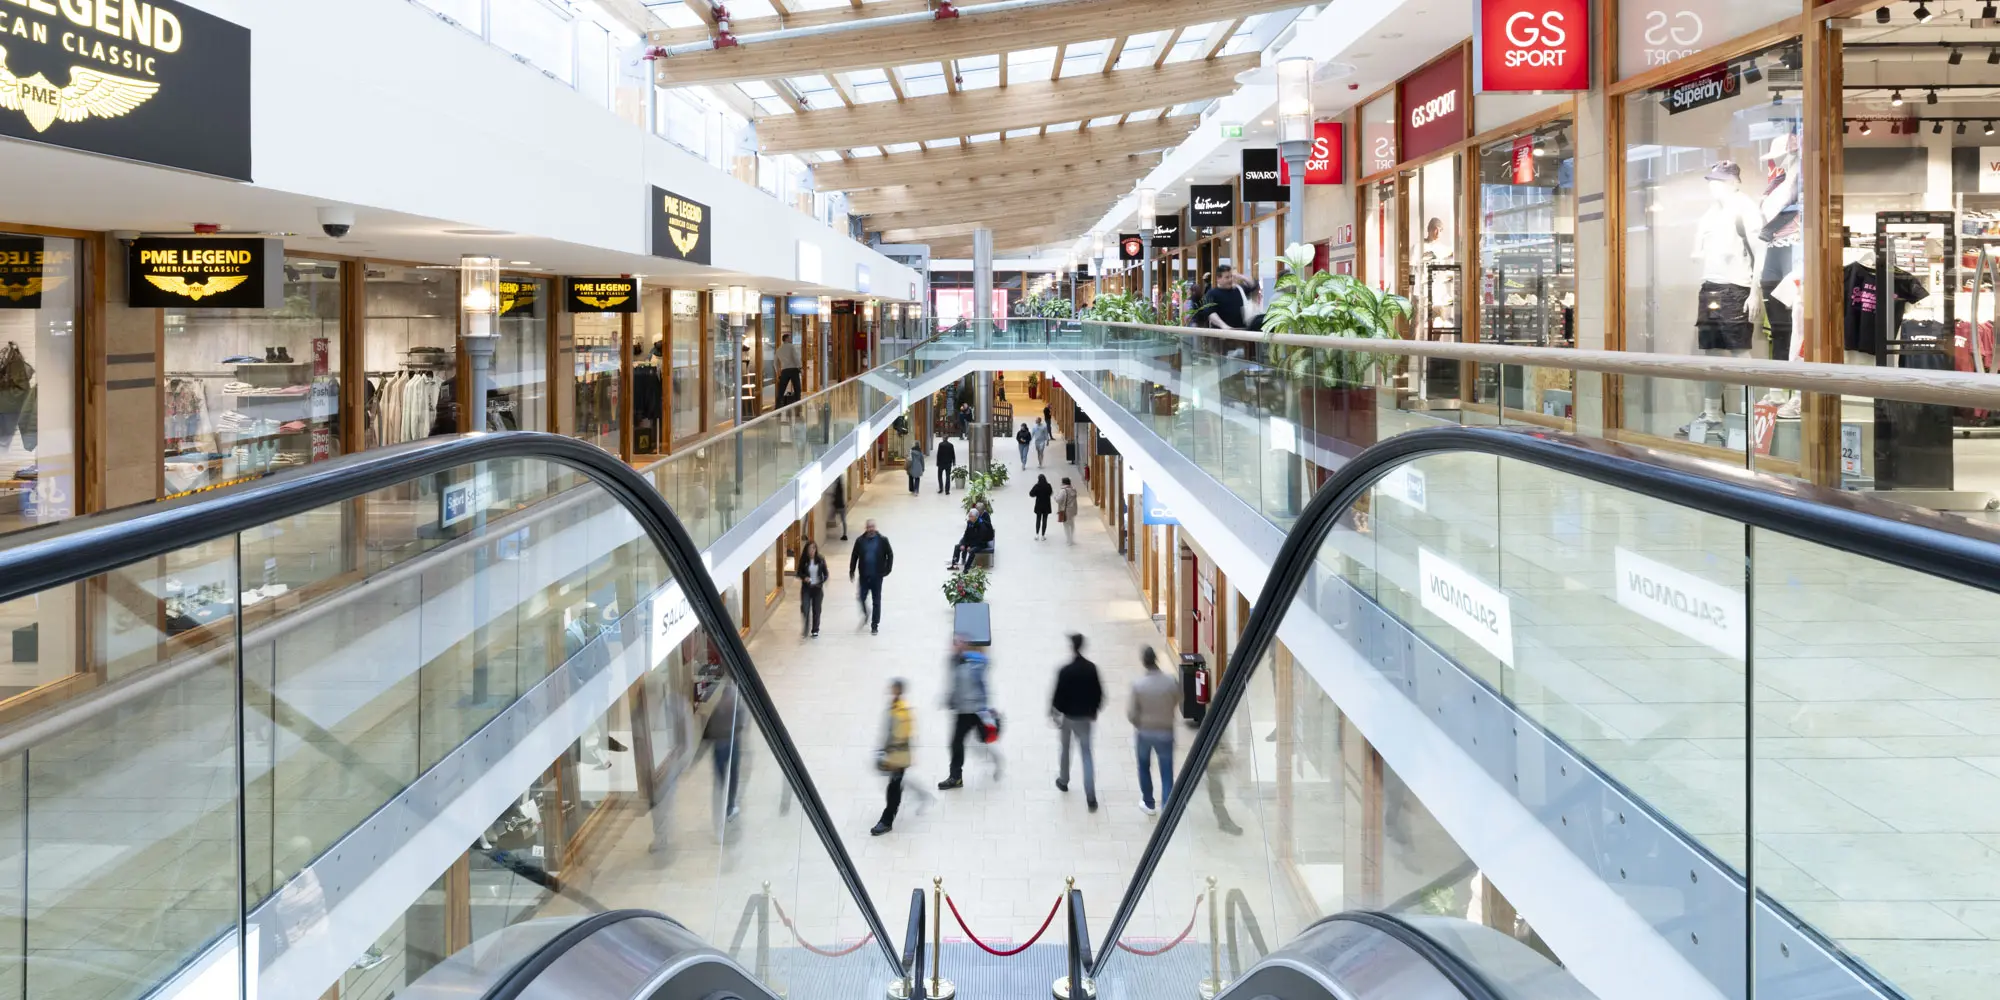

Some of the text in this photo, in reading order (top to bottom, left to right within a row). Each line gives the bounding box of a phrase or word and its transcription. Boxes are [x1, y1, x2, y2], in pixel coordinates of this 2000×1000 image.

[13, 0, 182, 53] GEND
[1505, 11, 1566, 47] GS
[62, 32, 156, 76] CLASSIC
[1504, 49, 1567, 67] SPORT
[21, 83, 57, 106] PME
[1673, 79, 1724, 109] Superdry
[1411, 89, 1456, 128] GS SPORT
[1310, 137, 1329, 158] S
[1245, 171, 1279, 180] SWAROV
[1305, 159, 1329, 171] ORT
[141, 250, 252, 265] PME LEGEND
[574, 283, 632, 293] PME LEGEND
[1754, 412, 1775, 446] 0%
[662, 597, 692, 637] SALO
